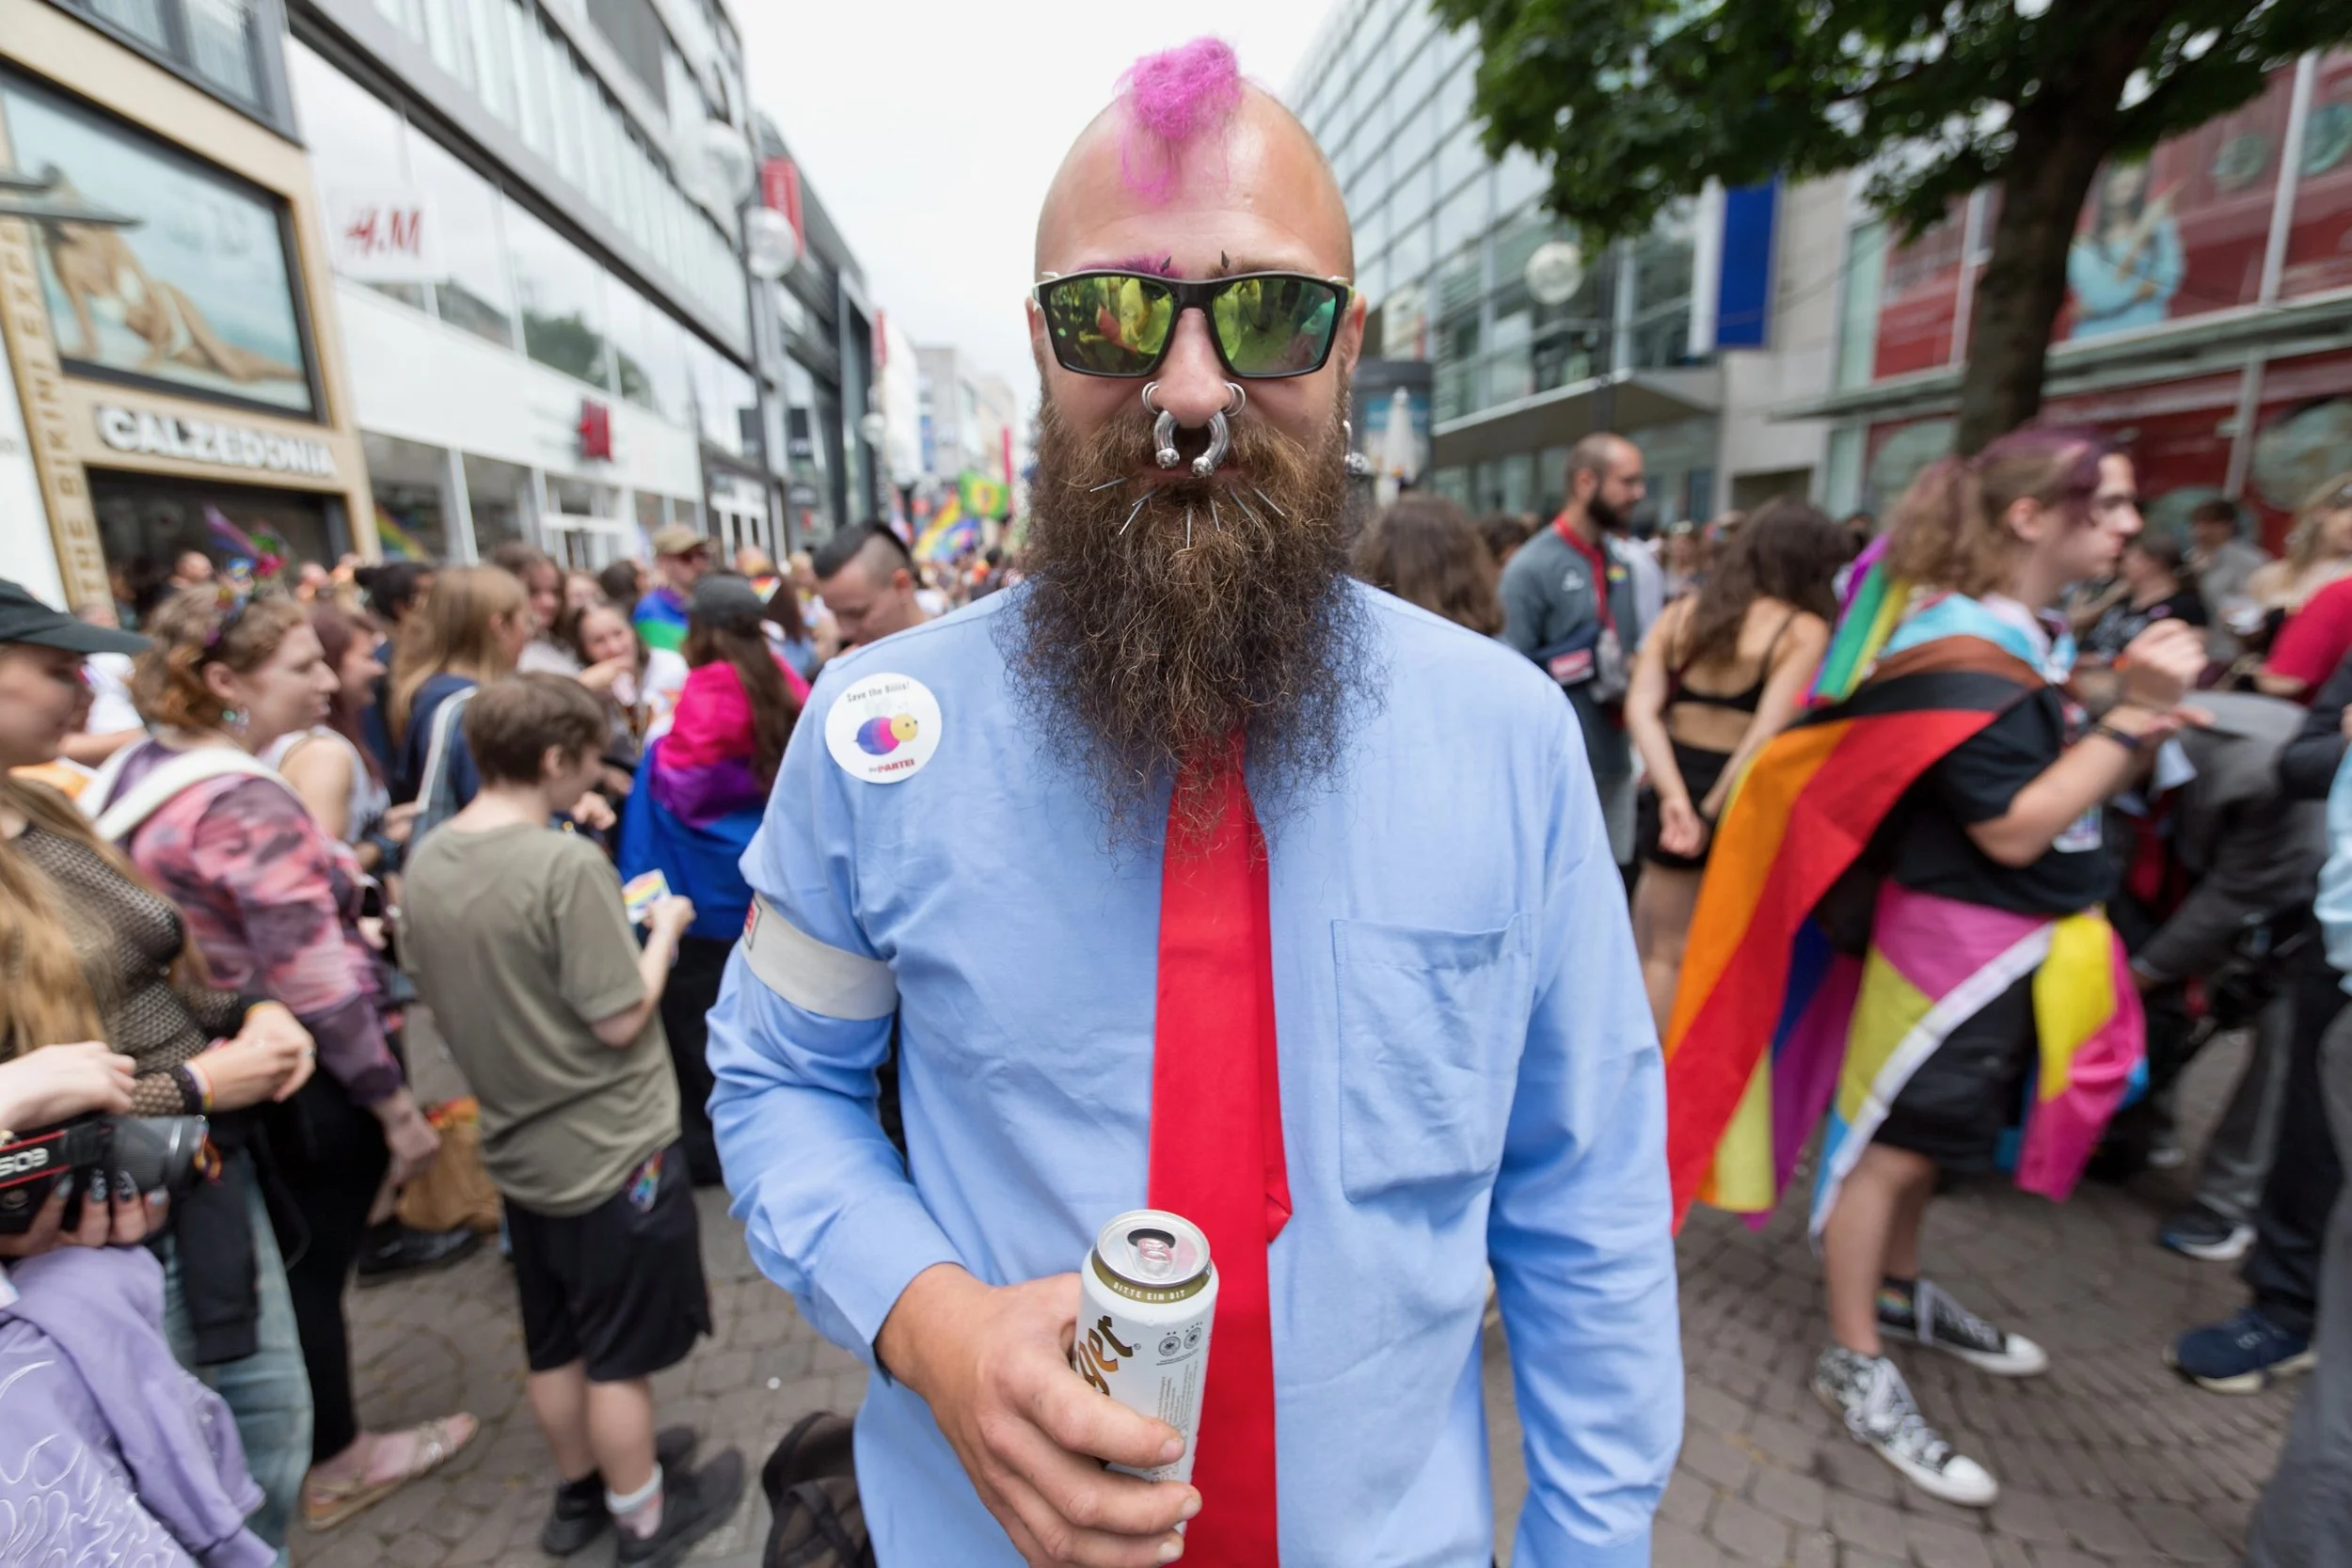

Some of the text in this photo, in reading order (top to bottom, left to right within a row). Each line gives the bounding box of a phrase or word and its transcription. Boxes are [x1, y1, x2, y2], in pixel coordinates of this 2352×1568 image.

[97, 405, 338, 476] CALZEDONIA
[0, 1148, 49, 1176] EOS
[1113, 1281, 1186, 1301] BITTE EIN BIT
[1078, 1315, 1134, 1397] ger
